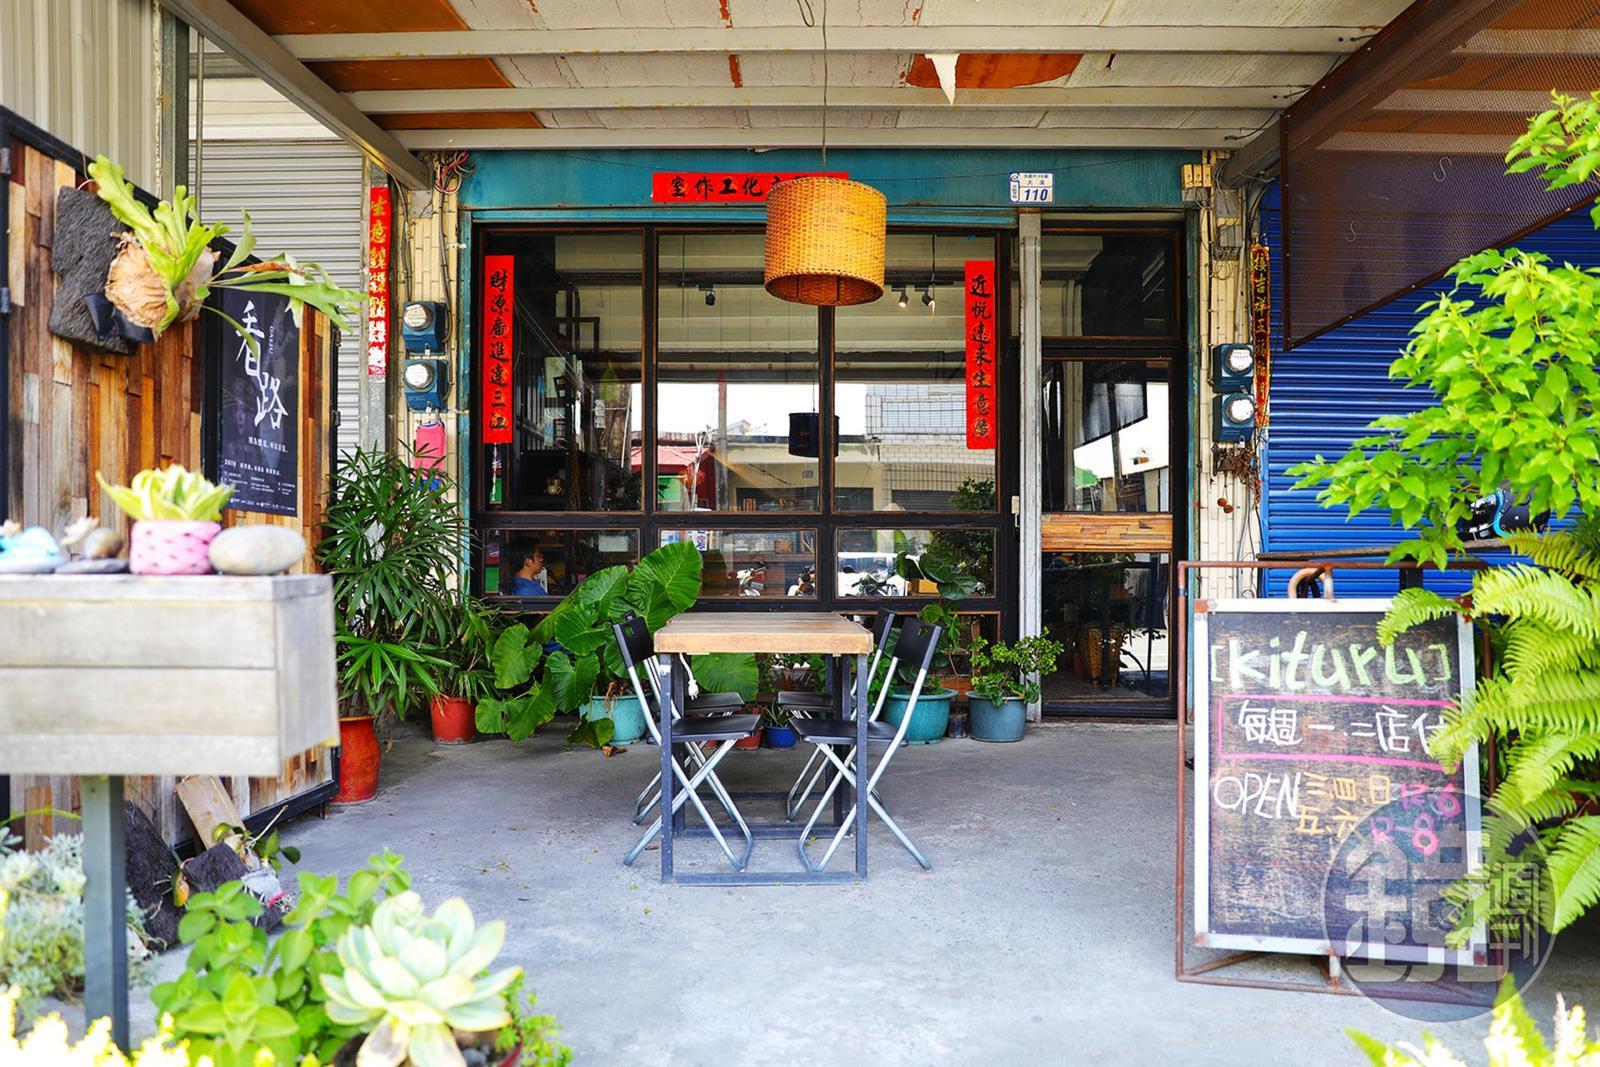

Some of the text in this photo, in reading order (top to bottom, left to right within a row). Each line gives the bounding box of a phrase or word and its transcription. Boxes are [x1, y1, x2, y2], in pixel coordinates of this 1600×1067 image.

[1024, 188, 1048, 201] 110
[489, 268, 509, 430] 財源廣進達三江
[1213, 772, 1301, 819] OPEN
